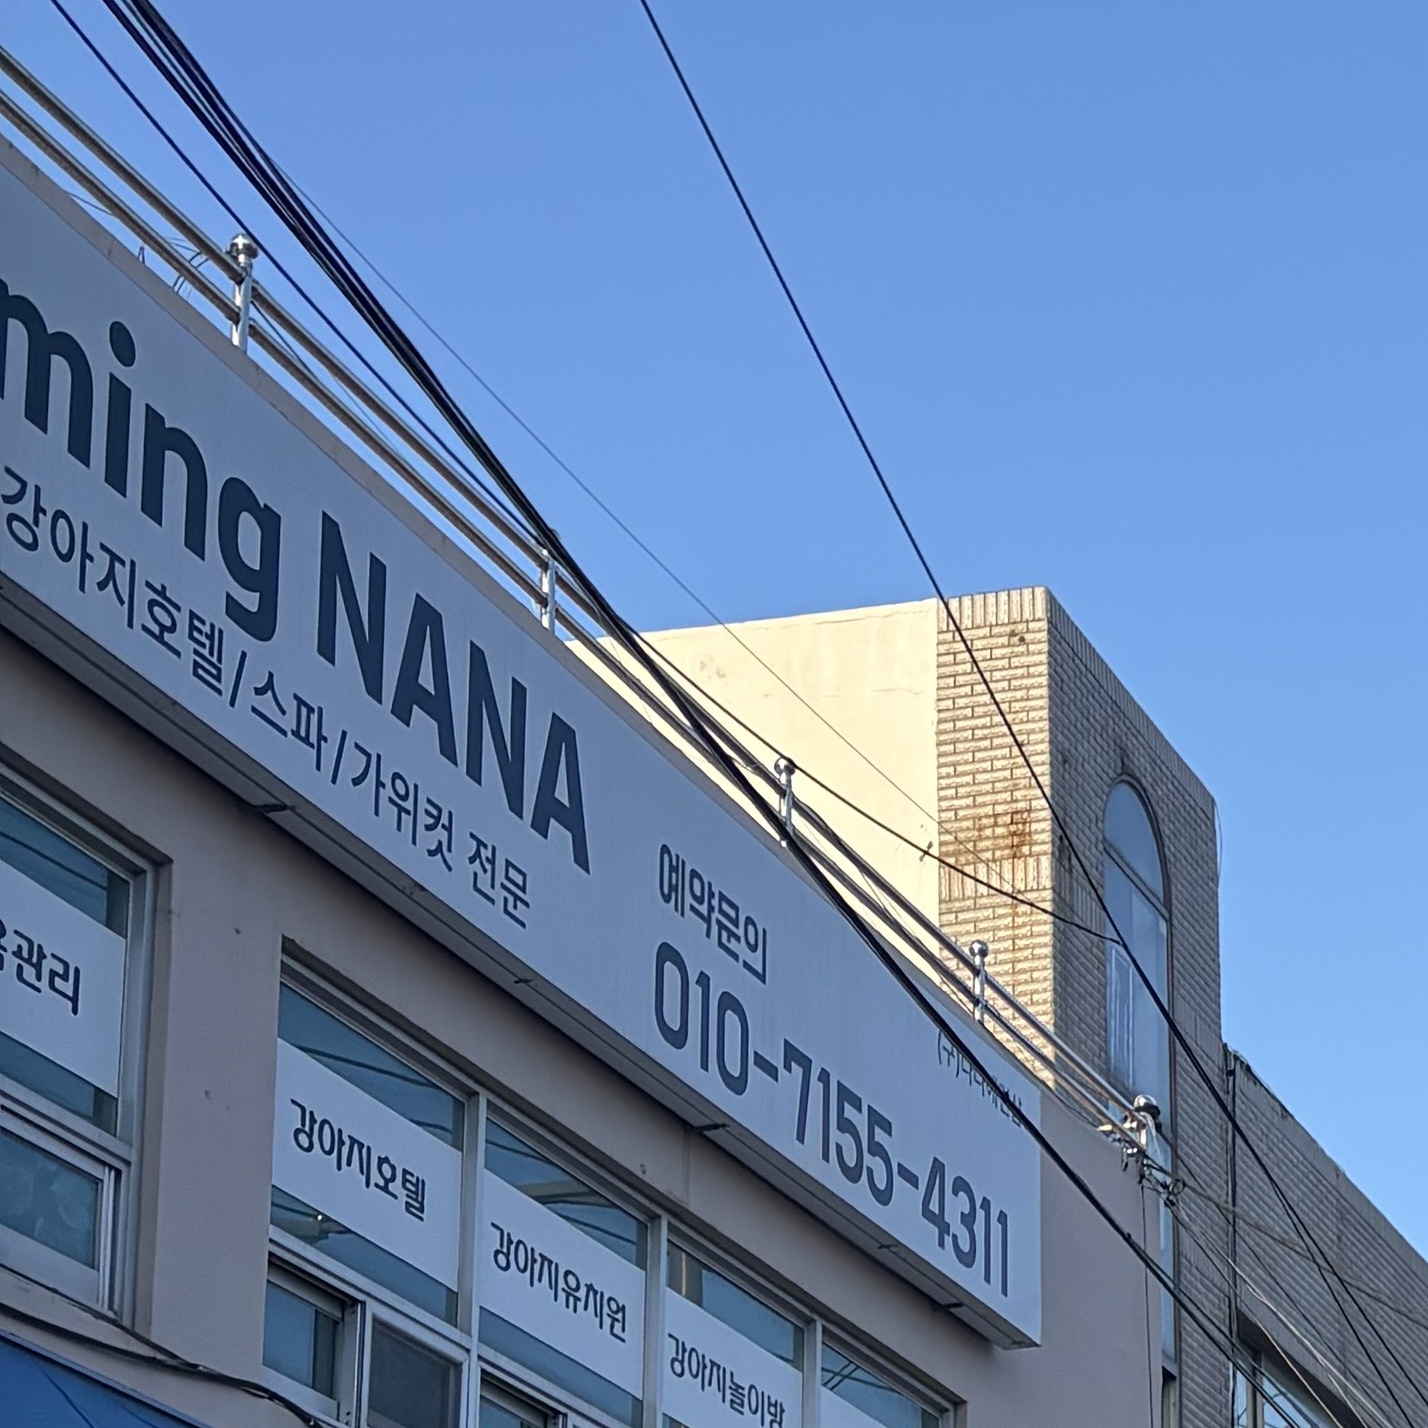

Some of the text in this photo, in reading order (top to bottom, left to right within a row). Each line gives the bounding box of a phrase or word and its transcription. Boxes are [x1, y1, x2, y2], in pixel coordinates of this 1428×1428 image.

[317, 510, 591, 876] NANA
[467, 831, 531, 930] 전문
[659, 843, 767, 986] 예약문의
[290, 1098, 427, 1222] 강아지호텔
[654, 942, 1009, 1298] 010-7155-4311
[490, 1222, 627, 1343] 강아지유치원
